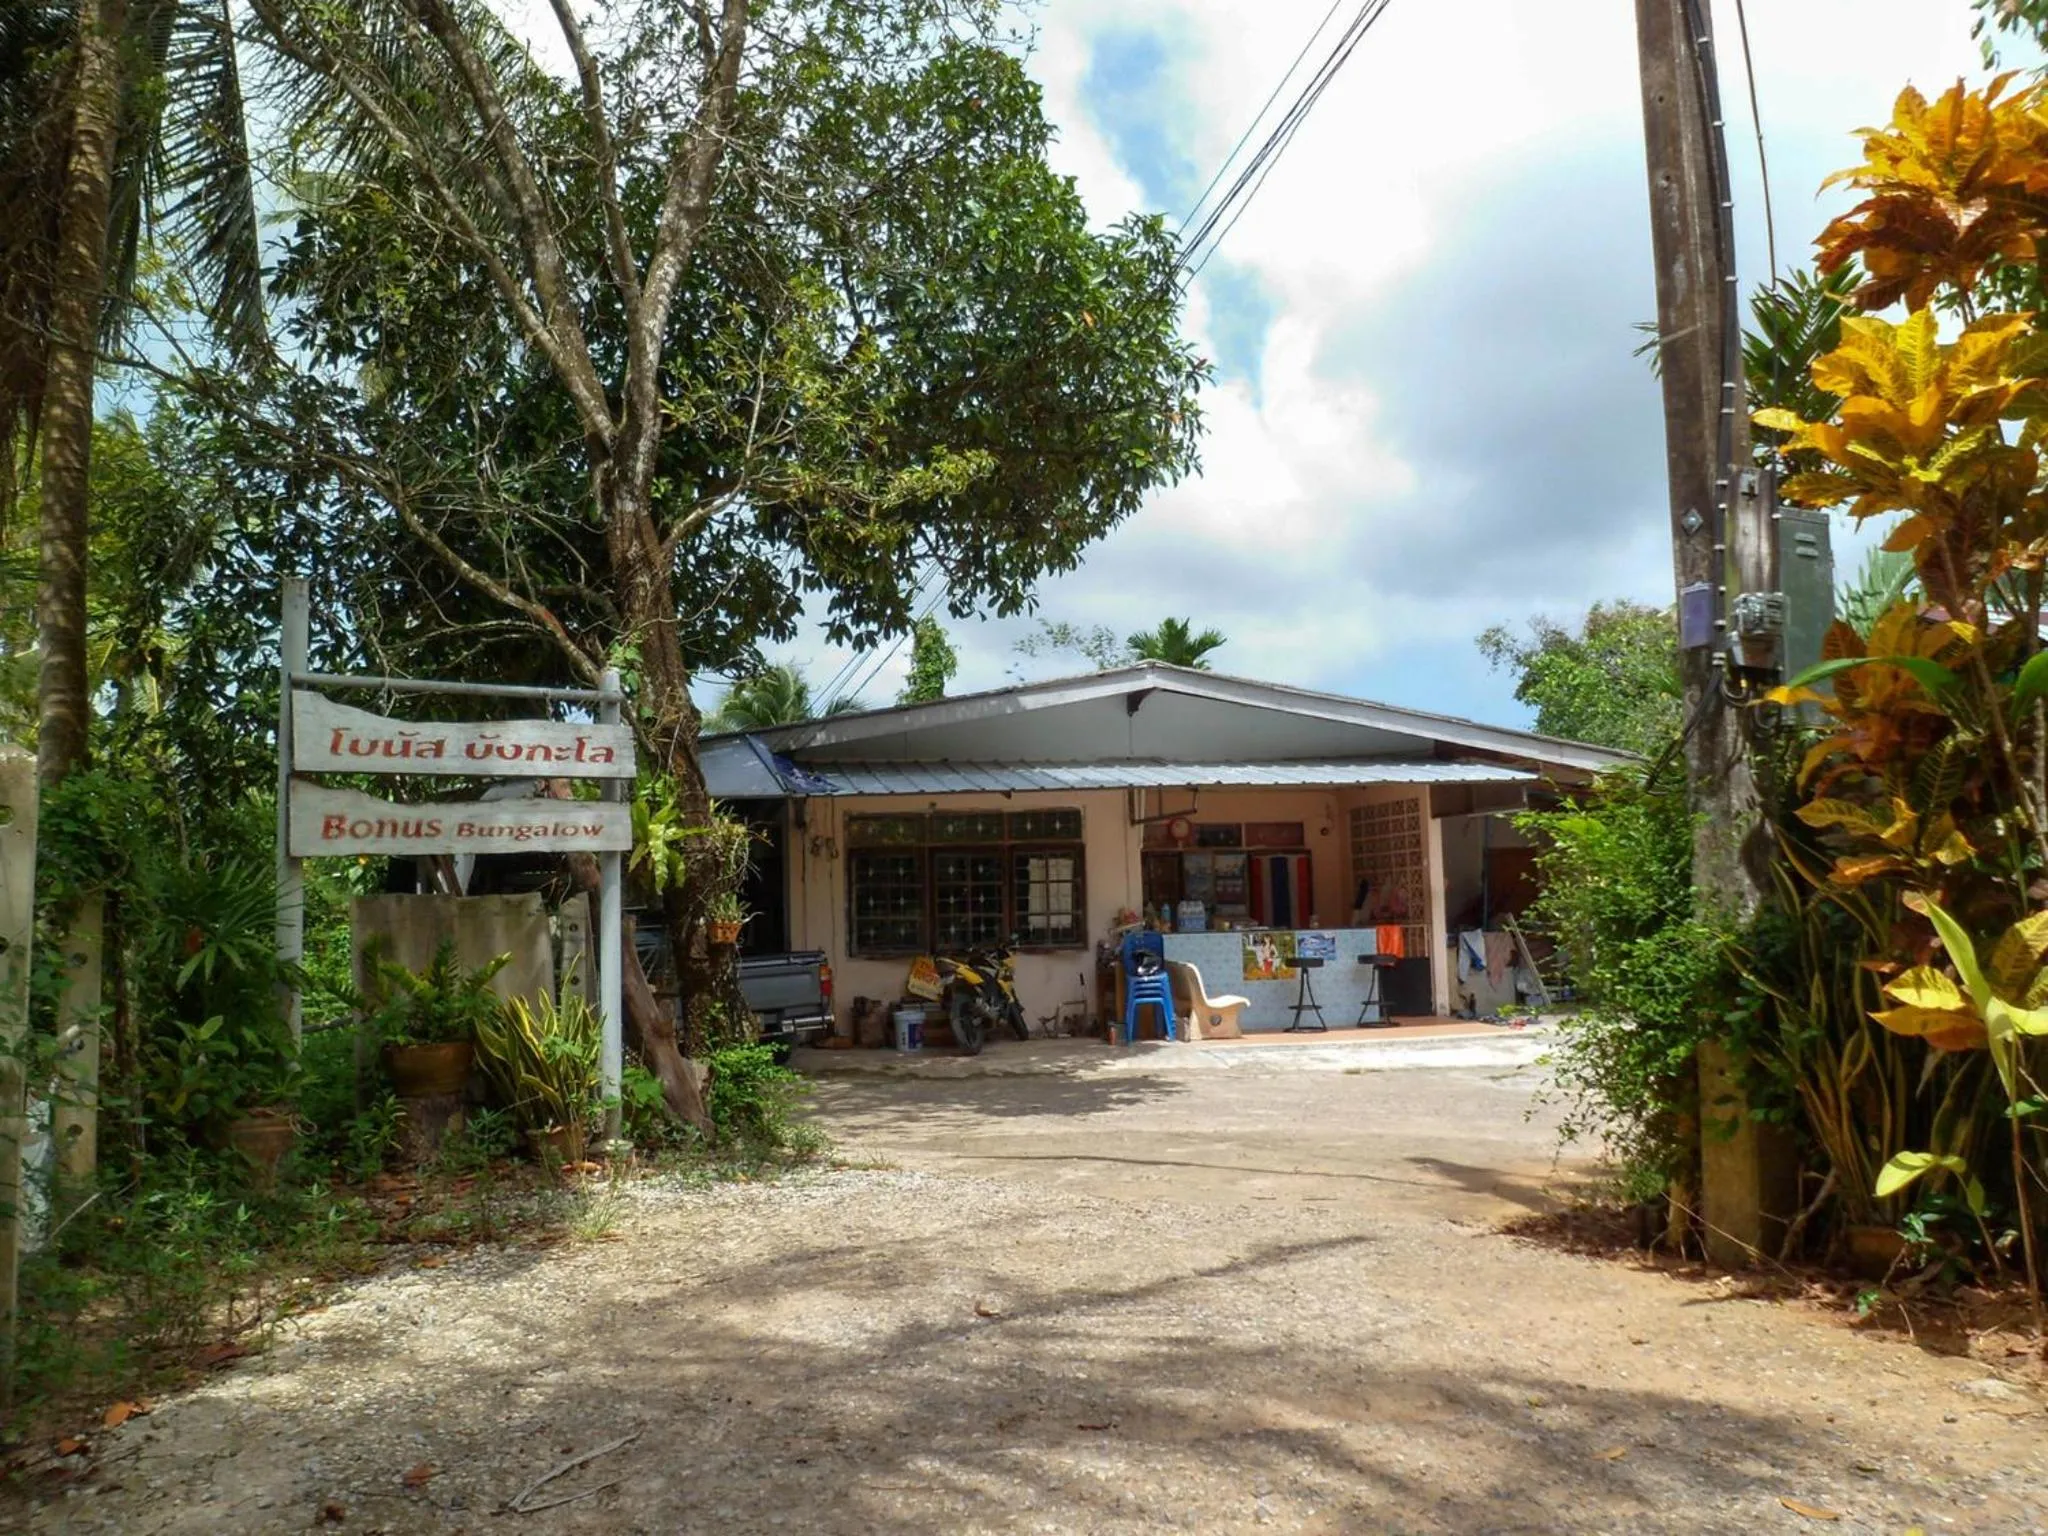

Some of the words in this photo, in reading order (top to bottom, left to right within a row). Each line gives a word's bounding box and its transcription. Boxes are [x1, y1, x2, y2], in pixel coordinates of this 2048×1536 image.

[330, 727, 446, 759] โบนัส
[465, 733, 615, 763] บังกะโล
[321, 815, 443, 840] Bonus
[456, 822, 605, 841] Bungalow
